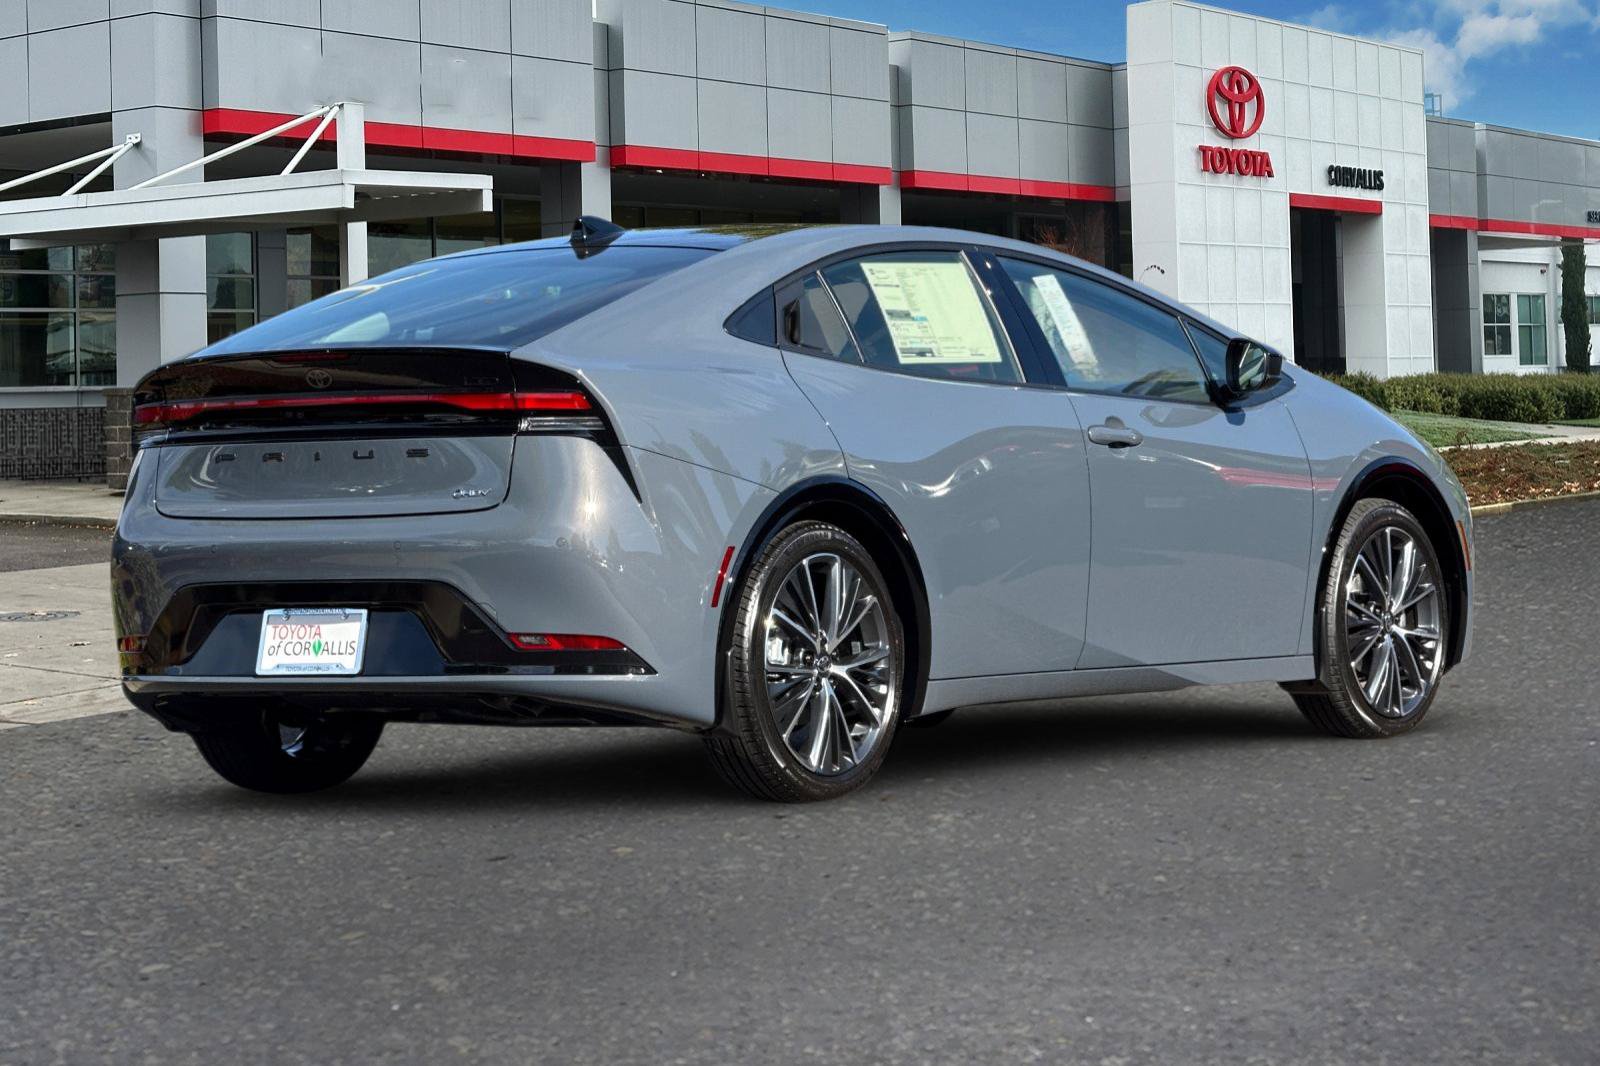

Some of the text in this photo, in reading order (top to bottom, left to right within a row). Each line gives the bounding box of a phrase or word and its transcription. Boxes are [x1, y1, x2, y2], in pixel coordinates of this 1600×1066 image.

[1198, 144, 1275, 178] TOYOTA
[1327, 164, 1385, 191] CORVALLIS
[215, 448, 430, 464] PRIUS
[271, 624, 322, 640] TOYOTA
[267, 641, 284, 657] of
